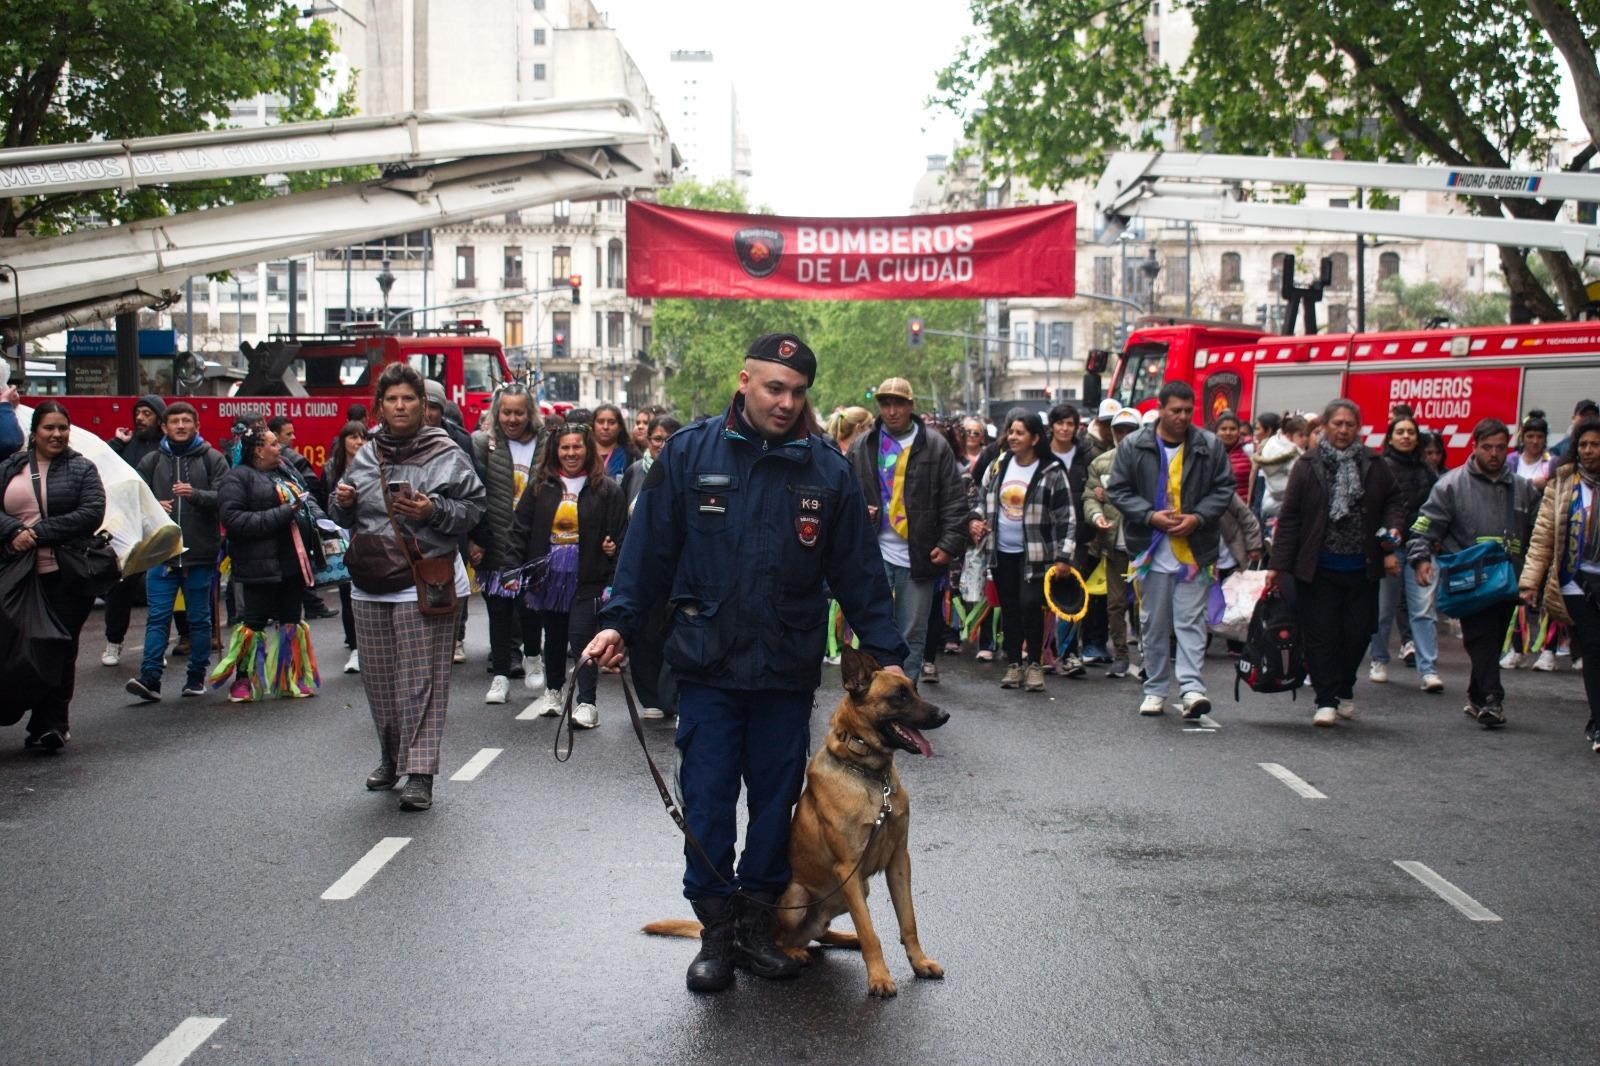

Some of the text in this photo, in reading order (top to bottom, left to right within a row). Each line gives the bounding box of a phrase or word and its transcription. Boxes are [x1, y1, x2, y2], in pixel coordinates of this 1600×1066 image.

[0, 141, 321, 187] MBEROS DE LA CIUDAD
[797, 226, 974, 254] BOMBEROS
[798, 259, 832, 282] DE
[840, 259, 871, 282] LA
[878, 258, 973, 282] CIUDAD
[453, 384, 465, 407] H
[1390, 376, 1473, 400] BOMBEROS
[219, 402, 338, 417] BOMBEROS DE LA CIUDAD
[1424, 400, 1471, 419] CIUDAD
